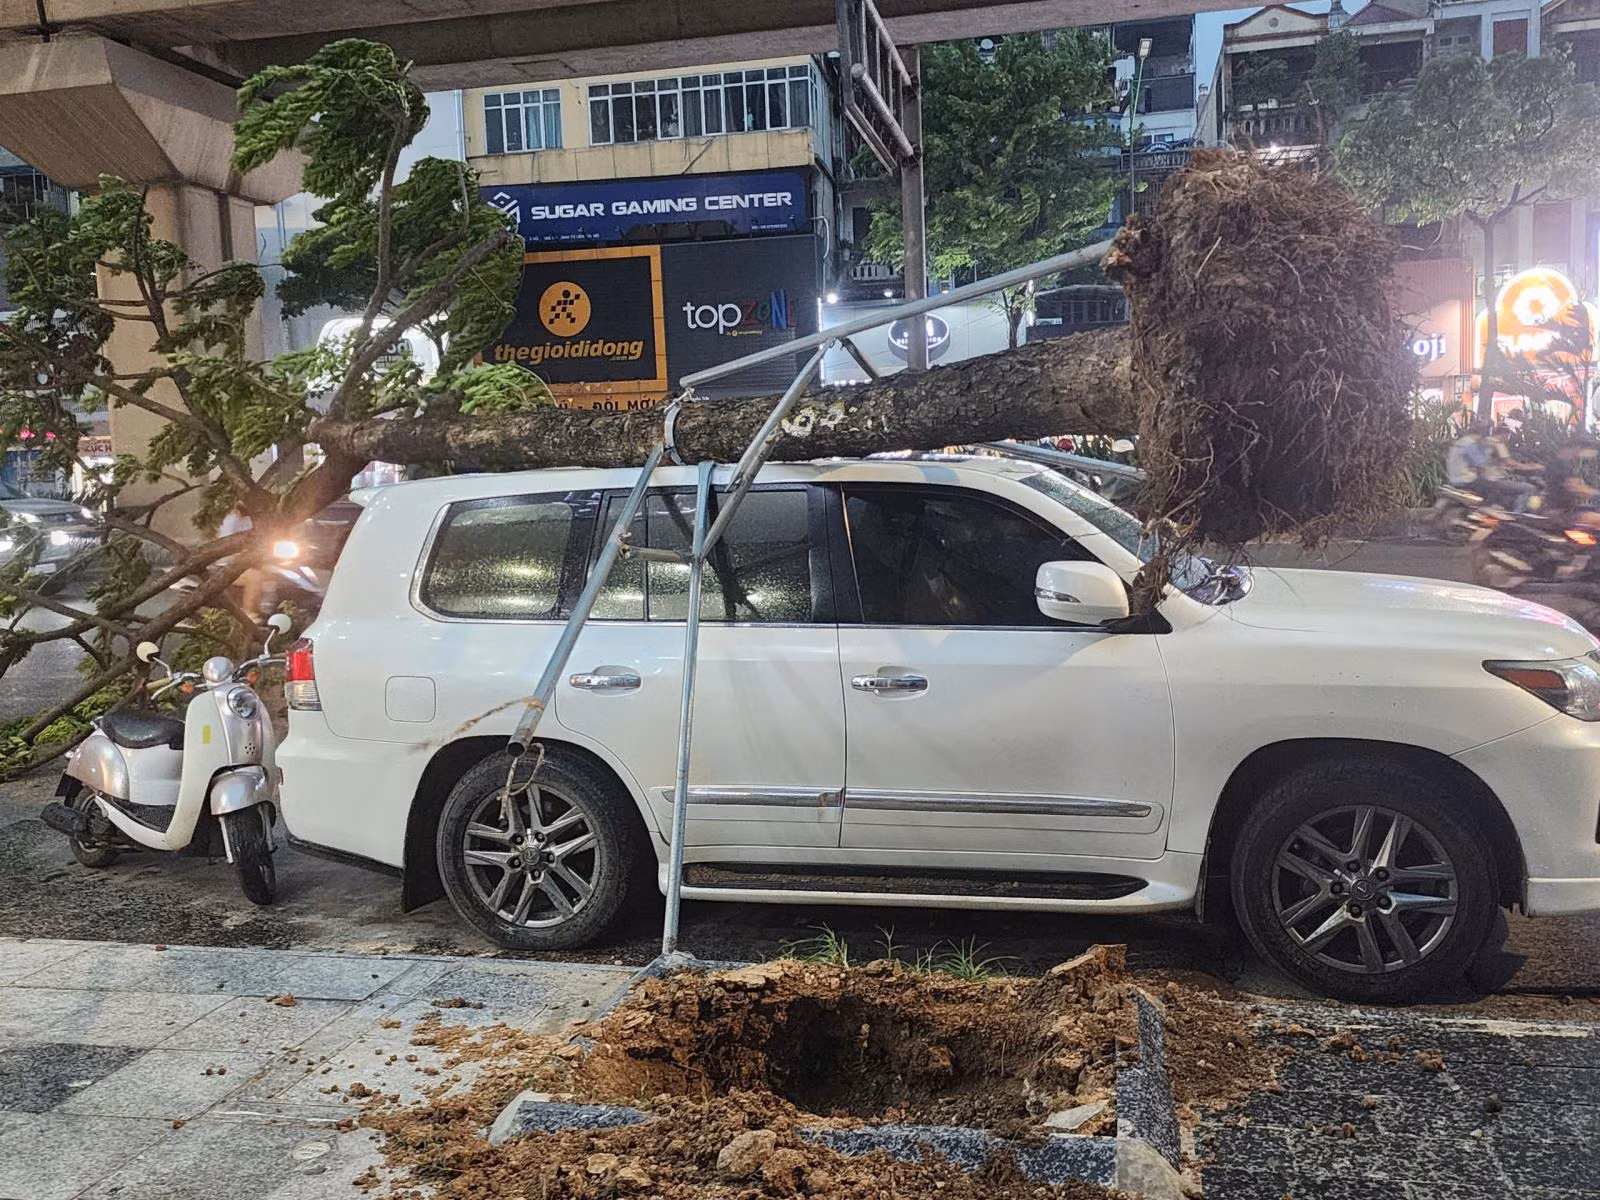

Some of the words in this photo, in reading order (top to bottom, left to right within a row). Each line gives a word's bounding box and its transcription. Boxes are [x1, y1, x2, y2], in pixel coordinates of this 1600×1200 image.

[531, 203, 605, 220] SUGAR
[611, 197, 697, 215] GAMING
[704, 191, 792, 210] CENTER
[495, 340, 643, 365] thegioididong
[1407, 333, 1446, 361] oji
